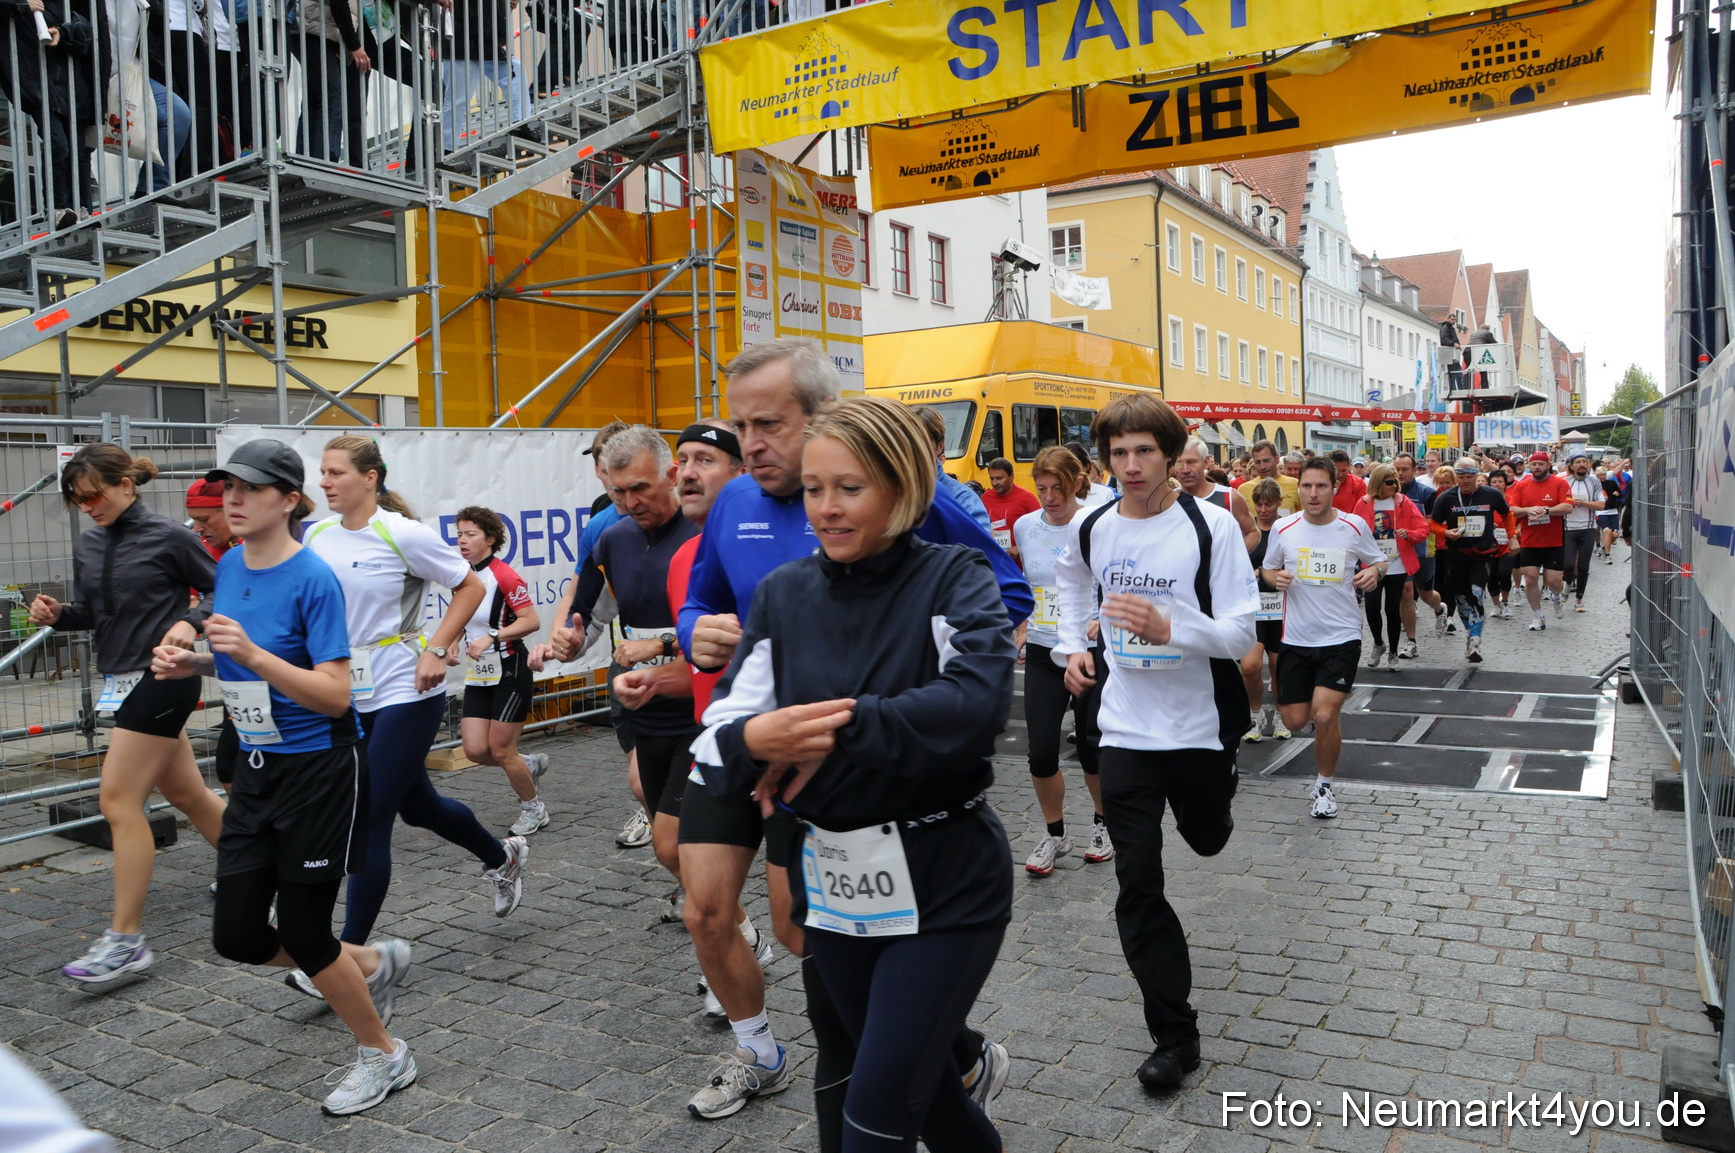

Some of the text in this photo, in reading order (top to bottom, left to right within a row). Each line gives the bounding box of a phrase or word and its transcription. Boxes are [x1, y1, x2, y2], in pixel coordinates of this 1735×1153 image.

[1399, 46, 1605, 98] Neumarkter Stadtlauf
[739, 66, 900, 113] Neumarkter Stadtlauf
[1126, 71, 1299, 151] ZIEL
[898, 143, 1041, 178] Neumarkter Stadtlauf
[816, 190, 858, 209] MERZ
[747, 239, 763, 249] KANN
[831, 253, 856, 263] WITTMANN
[742, 305, 772, 321] Sinupret
[828, 302, 863, 321] OBI
[743, 320, 761, 332] forte
[899, 388, 953, 401] TIMING
[1477, 419, 1552, 440] APPLAUS
[1314, 562, 1337, 574] 318
[1110, 572, 1177, 588] Fischer
[475, 663, 494, 675] 846
[815, 839, 849, 862] Doris
[303, 859, 329, 869] JAKO
[825, 870, 894, 900] 2640
